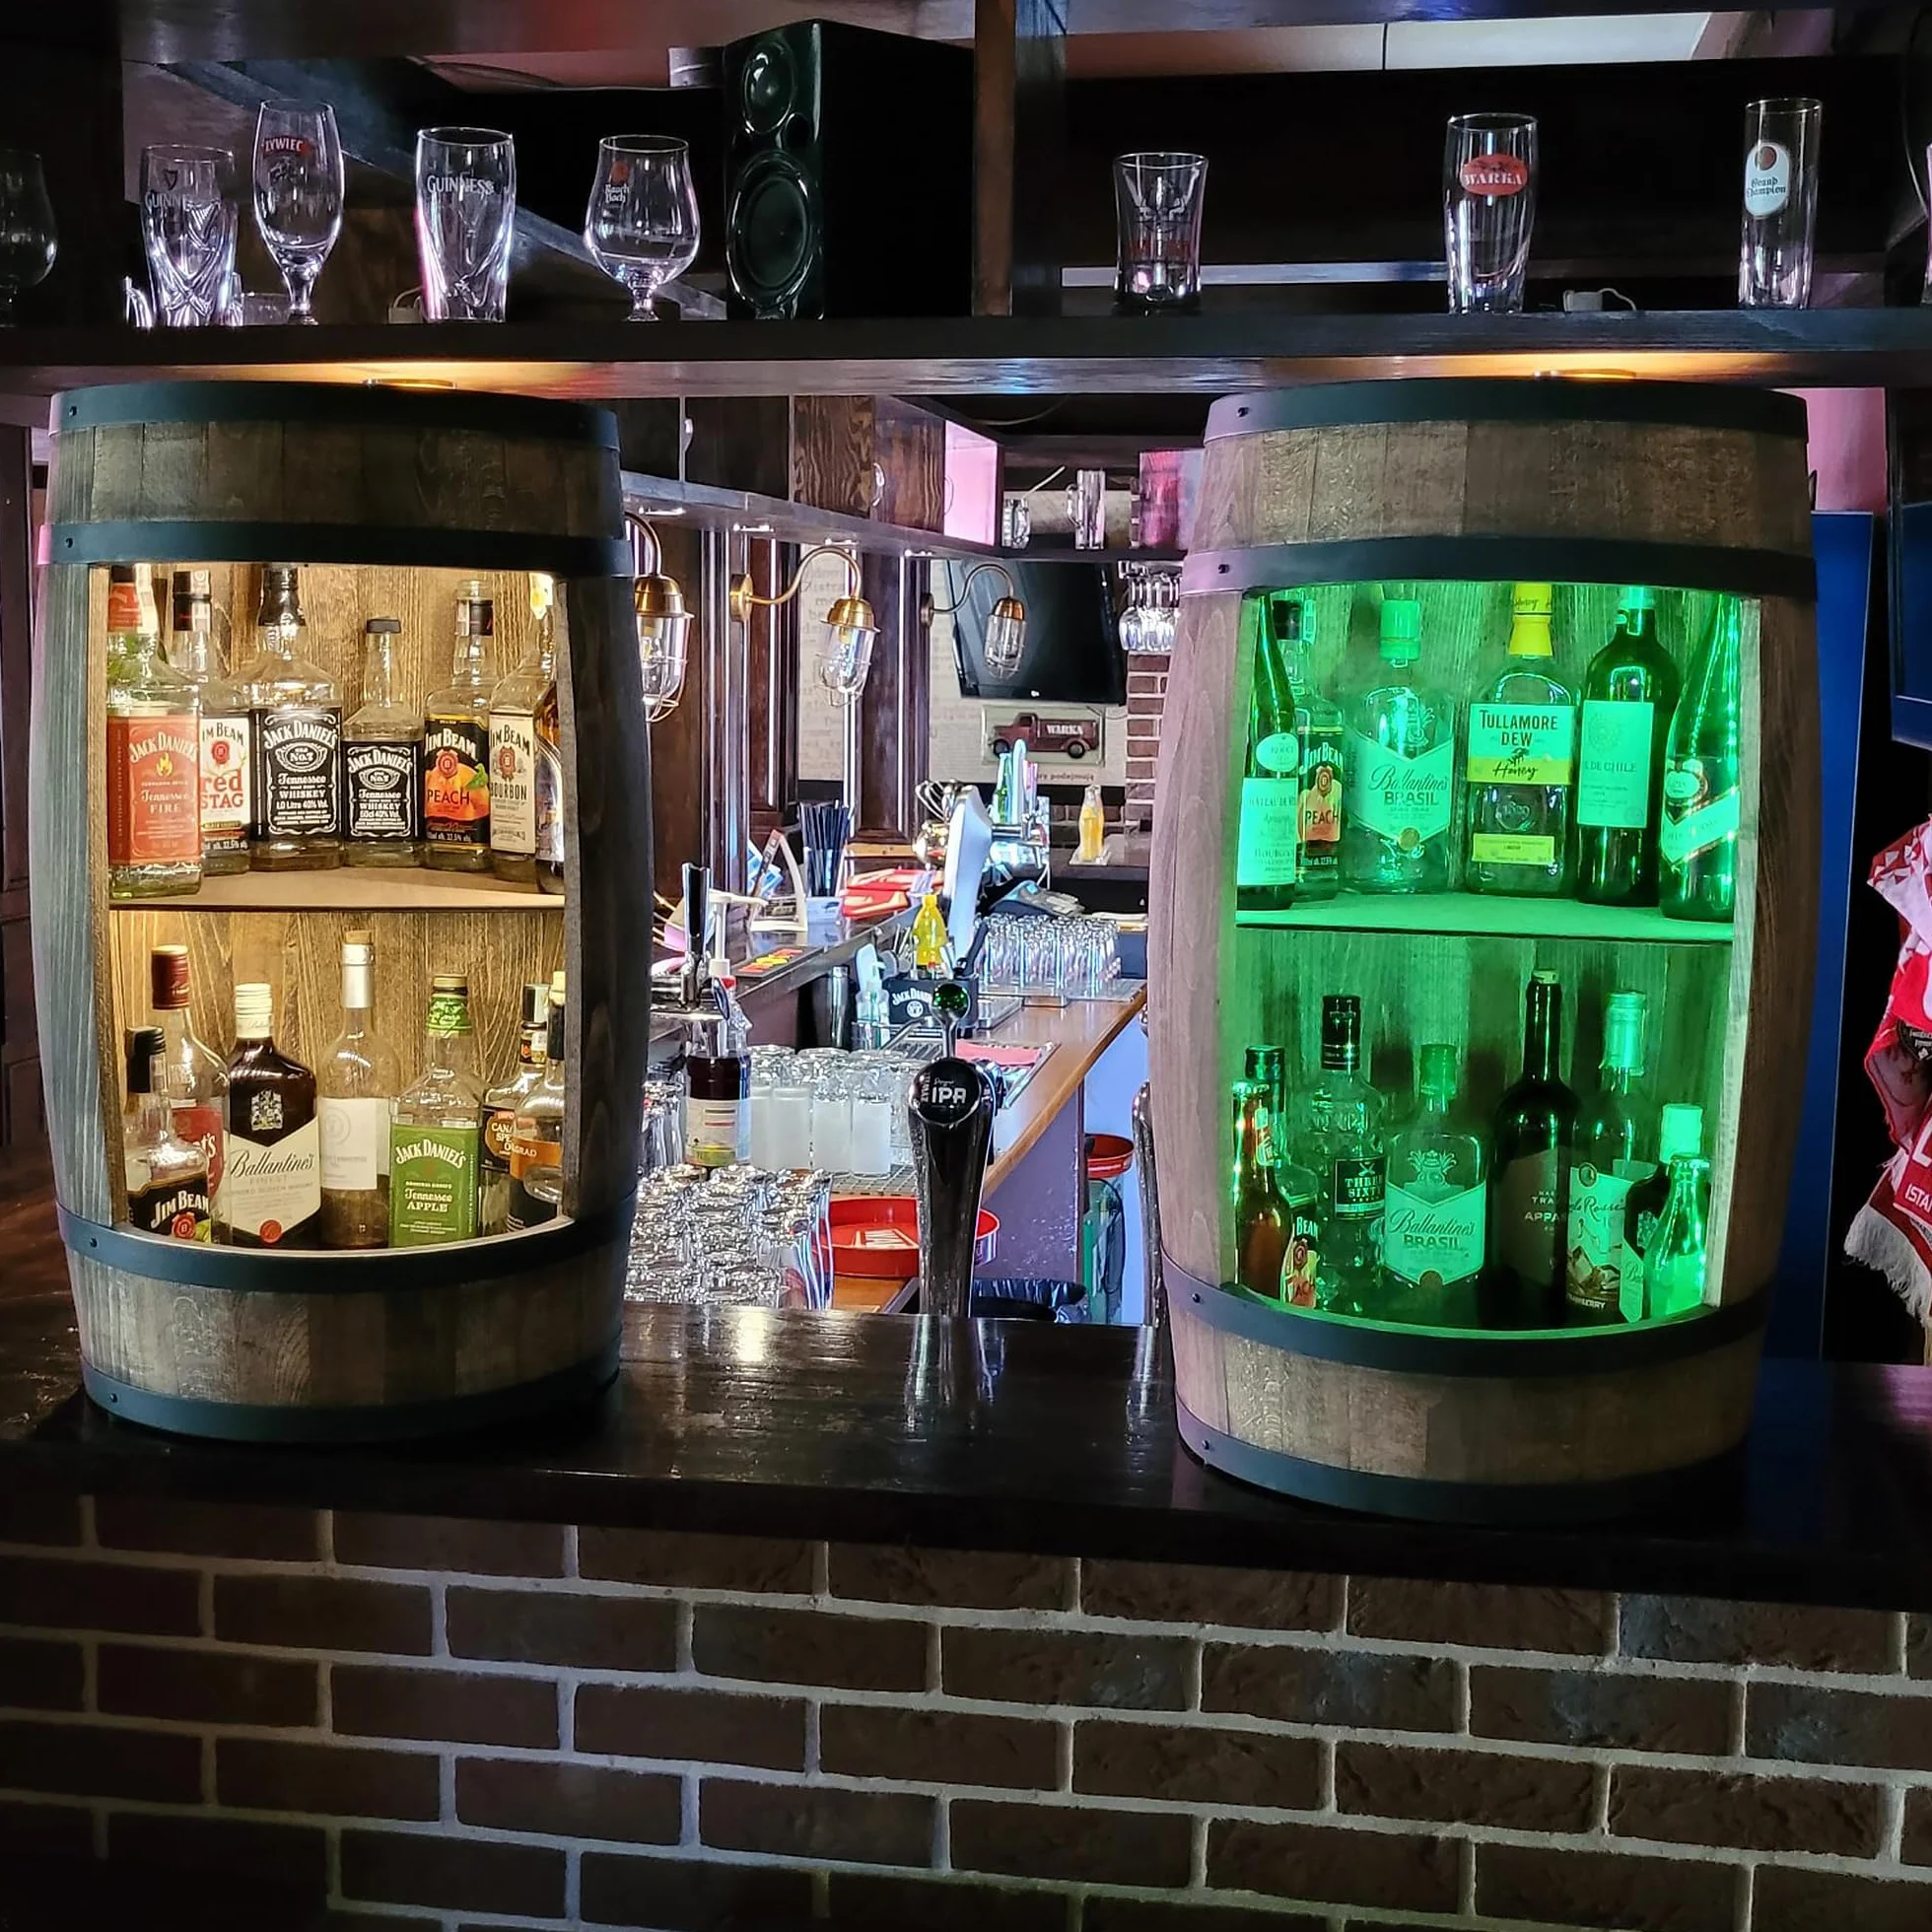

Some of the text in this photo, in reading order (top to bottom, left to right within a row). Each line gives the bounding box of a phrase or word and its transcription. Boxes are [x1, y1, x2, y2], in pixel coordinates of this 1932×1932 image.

[427, 174, 495, 195] GUINNESS
[1463, 172, 1523, 185] WARKA
[1480, 710, 1558, 729] TULLAMORE
[202, 722, 244, 745] IM BEAM
[262, 720, 337, 749] JACK DANIEL'S
[1046, 724, 1083, 736] WARKA
[1501, 731, 1533, 746] DEW
[129, 738, 157, 763] JACK
[424, 727, 478, 762] JIM BEAM
[504, 724, 530, 757] BEAM
[347, 749, 413, 774] JACK DANIEL'S
[1298, 746, 1321, 776] JIM
[1492, 761, 1538, 781] Honey
[201, 768, 242, 793] red
[277, 773, 326, 785] Tennessee
[1368, 764, 1449, 791] Ballantine's
[201, 793, 243, 808] STAG
[278, 790, 326, 799] WHISKEY
[427, 789, 470, 805] PEACH
[1384, 791, 1440, 806] BRASIL
[1305, 808, 1339, 825] PEACH
[932, 1087, 966, 1103] IPA
[230, 1148, 314, 1179] Ballantine's
[395, 1138, 466, 1169] JACK DANIEL'S
[151, 1198, 176, 1229] JIM
[406, 1201, 448, 1212] APPLE
[1388, 1208, 1476, 1236] Ballantine's
[1404, 1234, 1464, 1251] BRASIL
